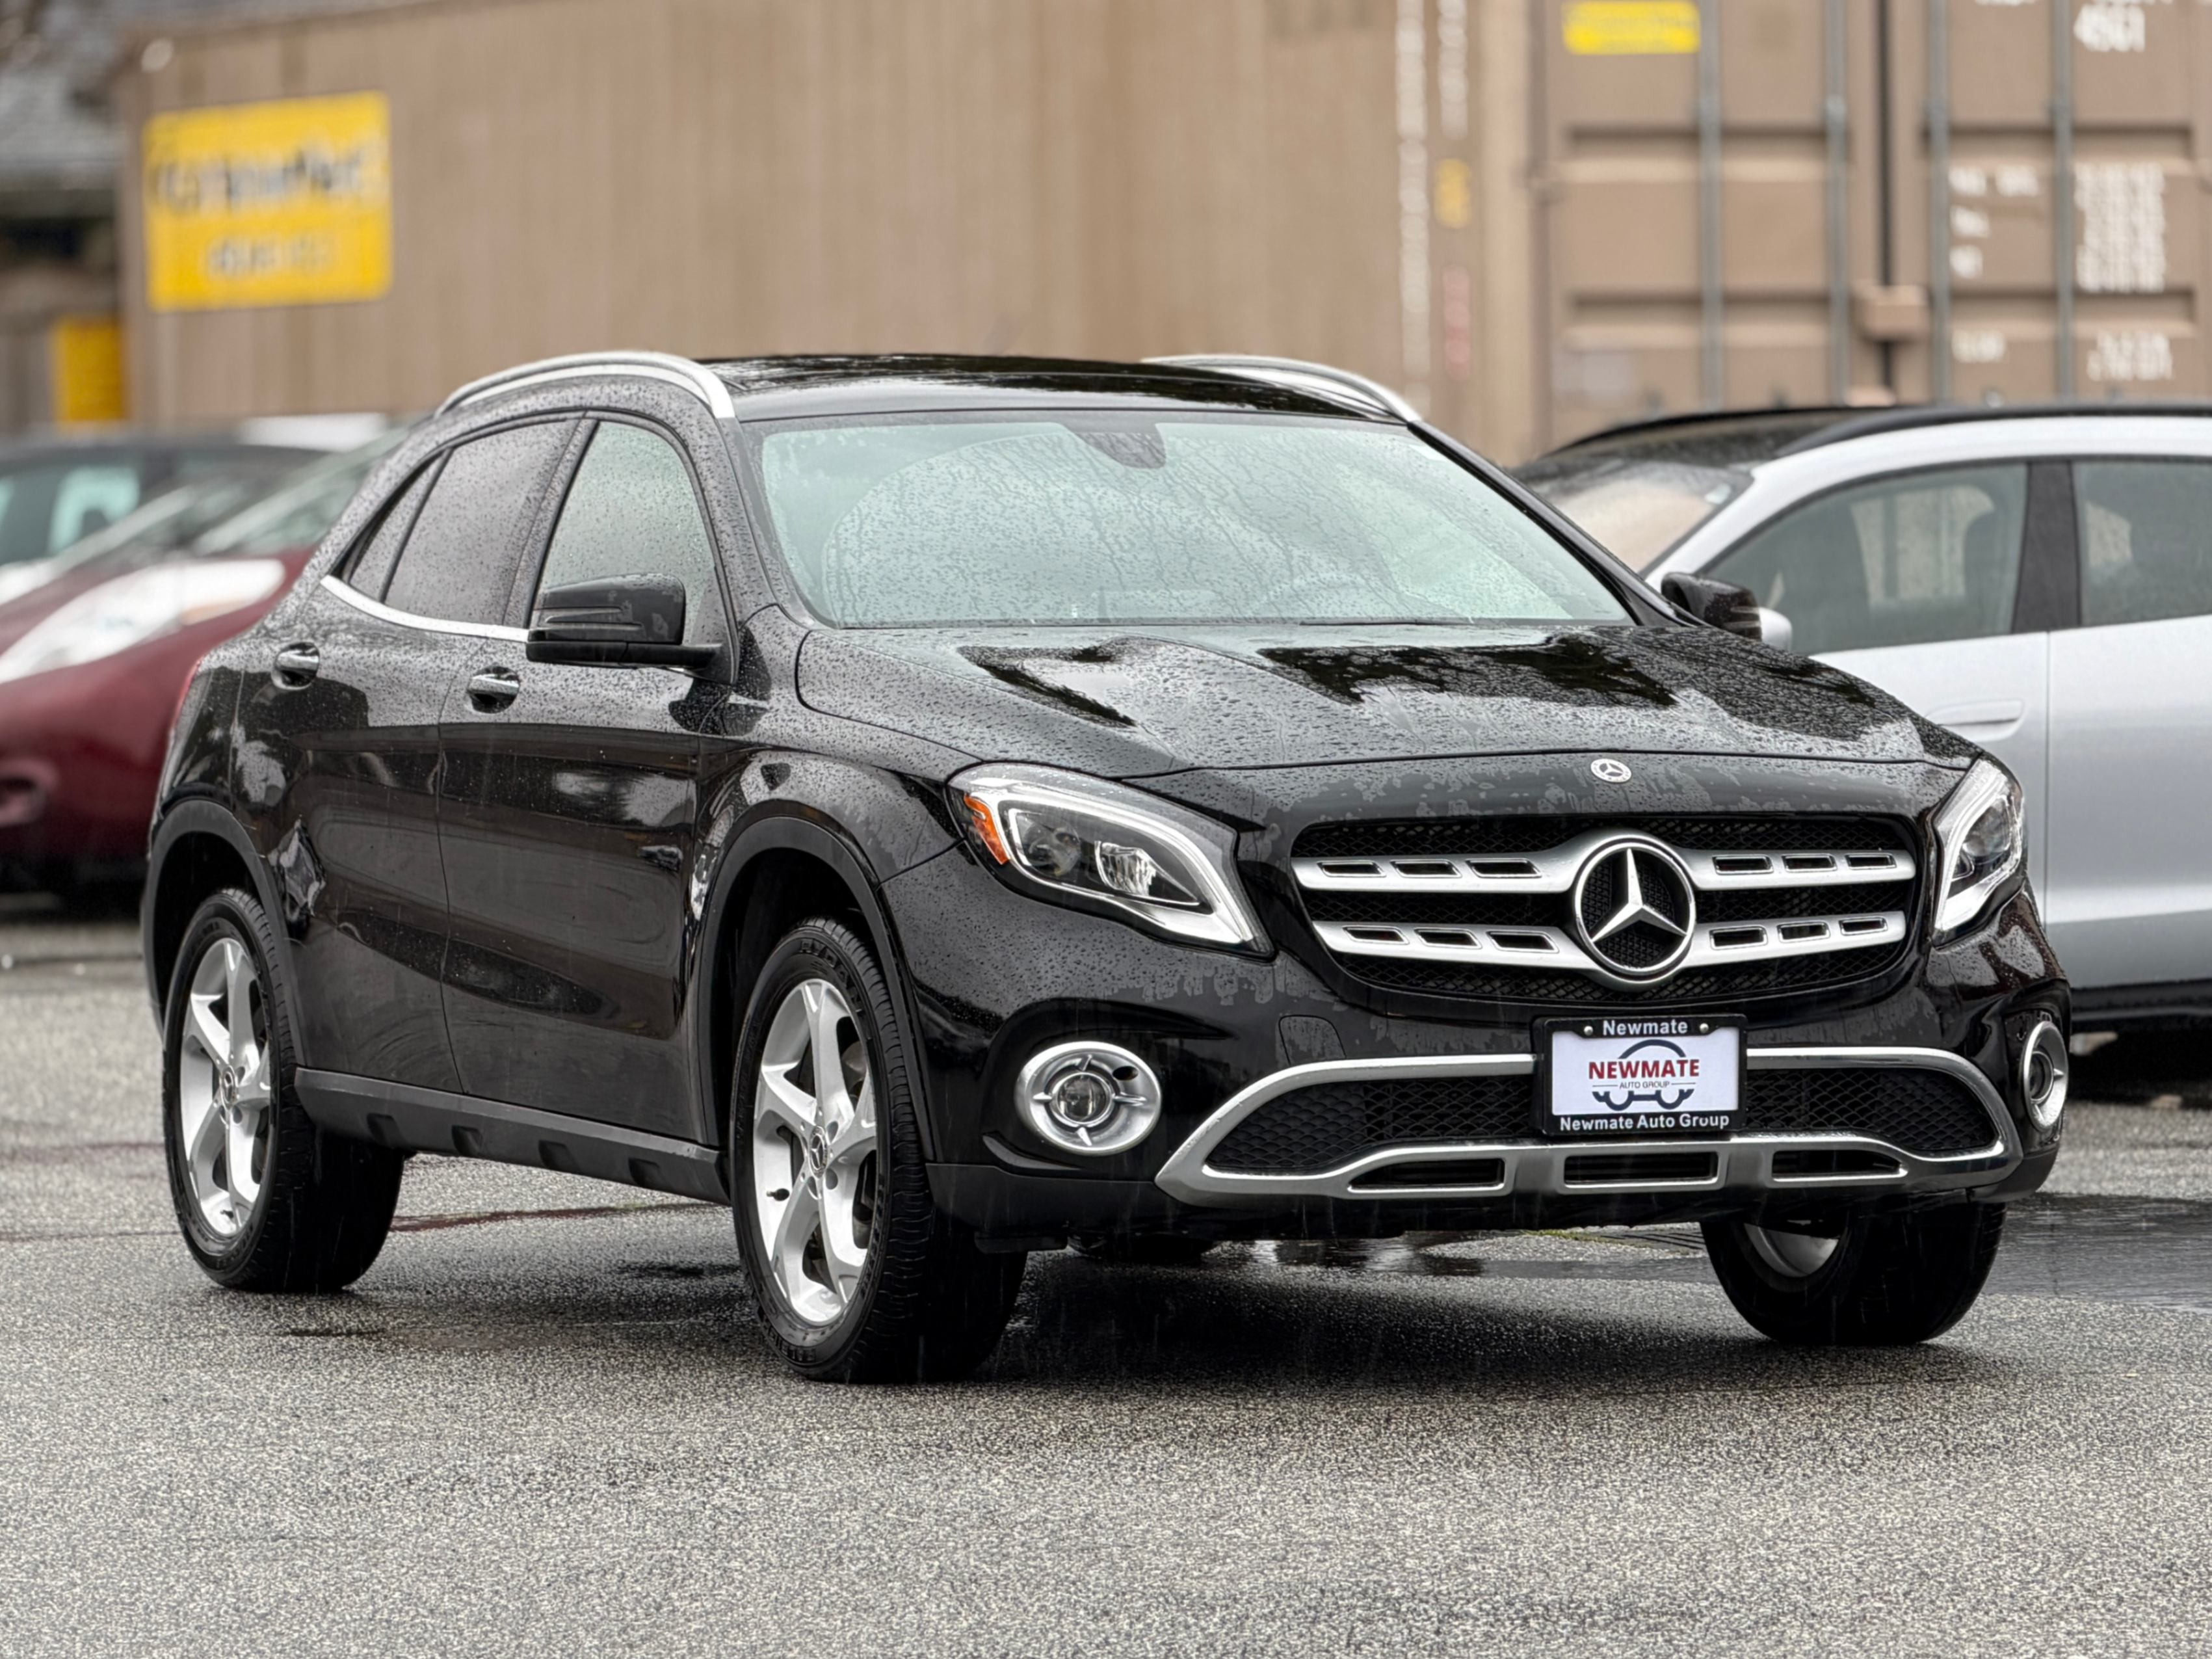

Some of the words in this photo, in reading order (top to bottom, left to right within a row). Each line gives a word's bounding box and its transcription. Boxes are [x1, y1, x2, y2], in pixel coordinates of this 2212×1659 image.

[1602, 1019, 1689, 1036] Newmate
[1588, 1059, 1700, 1080] NEWMATE
[1560, 1115, 1634, 1131] Newmate
[1637, 1115, 1676, 1129] Auto
[1679, 1113, 1730, 1129] Group
